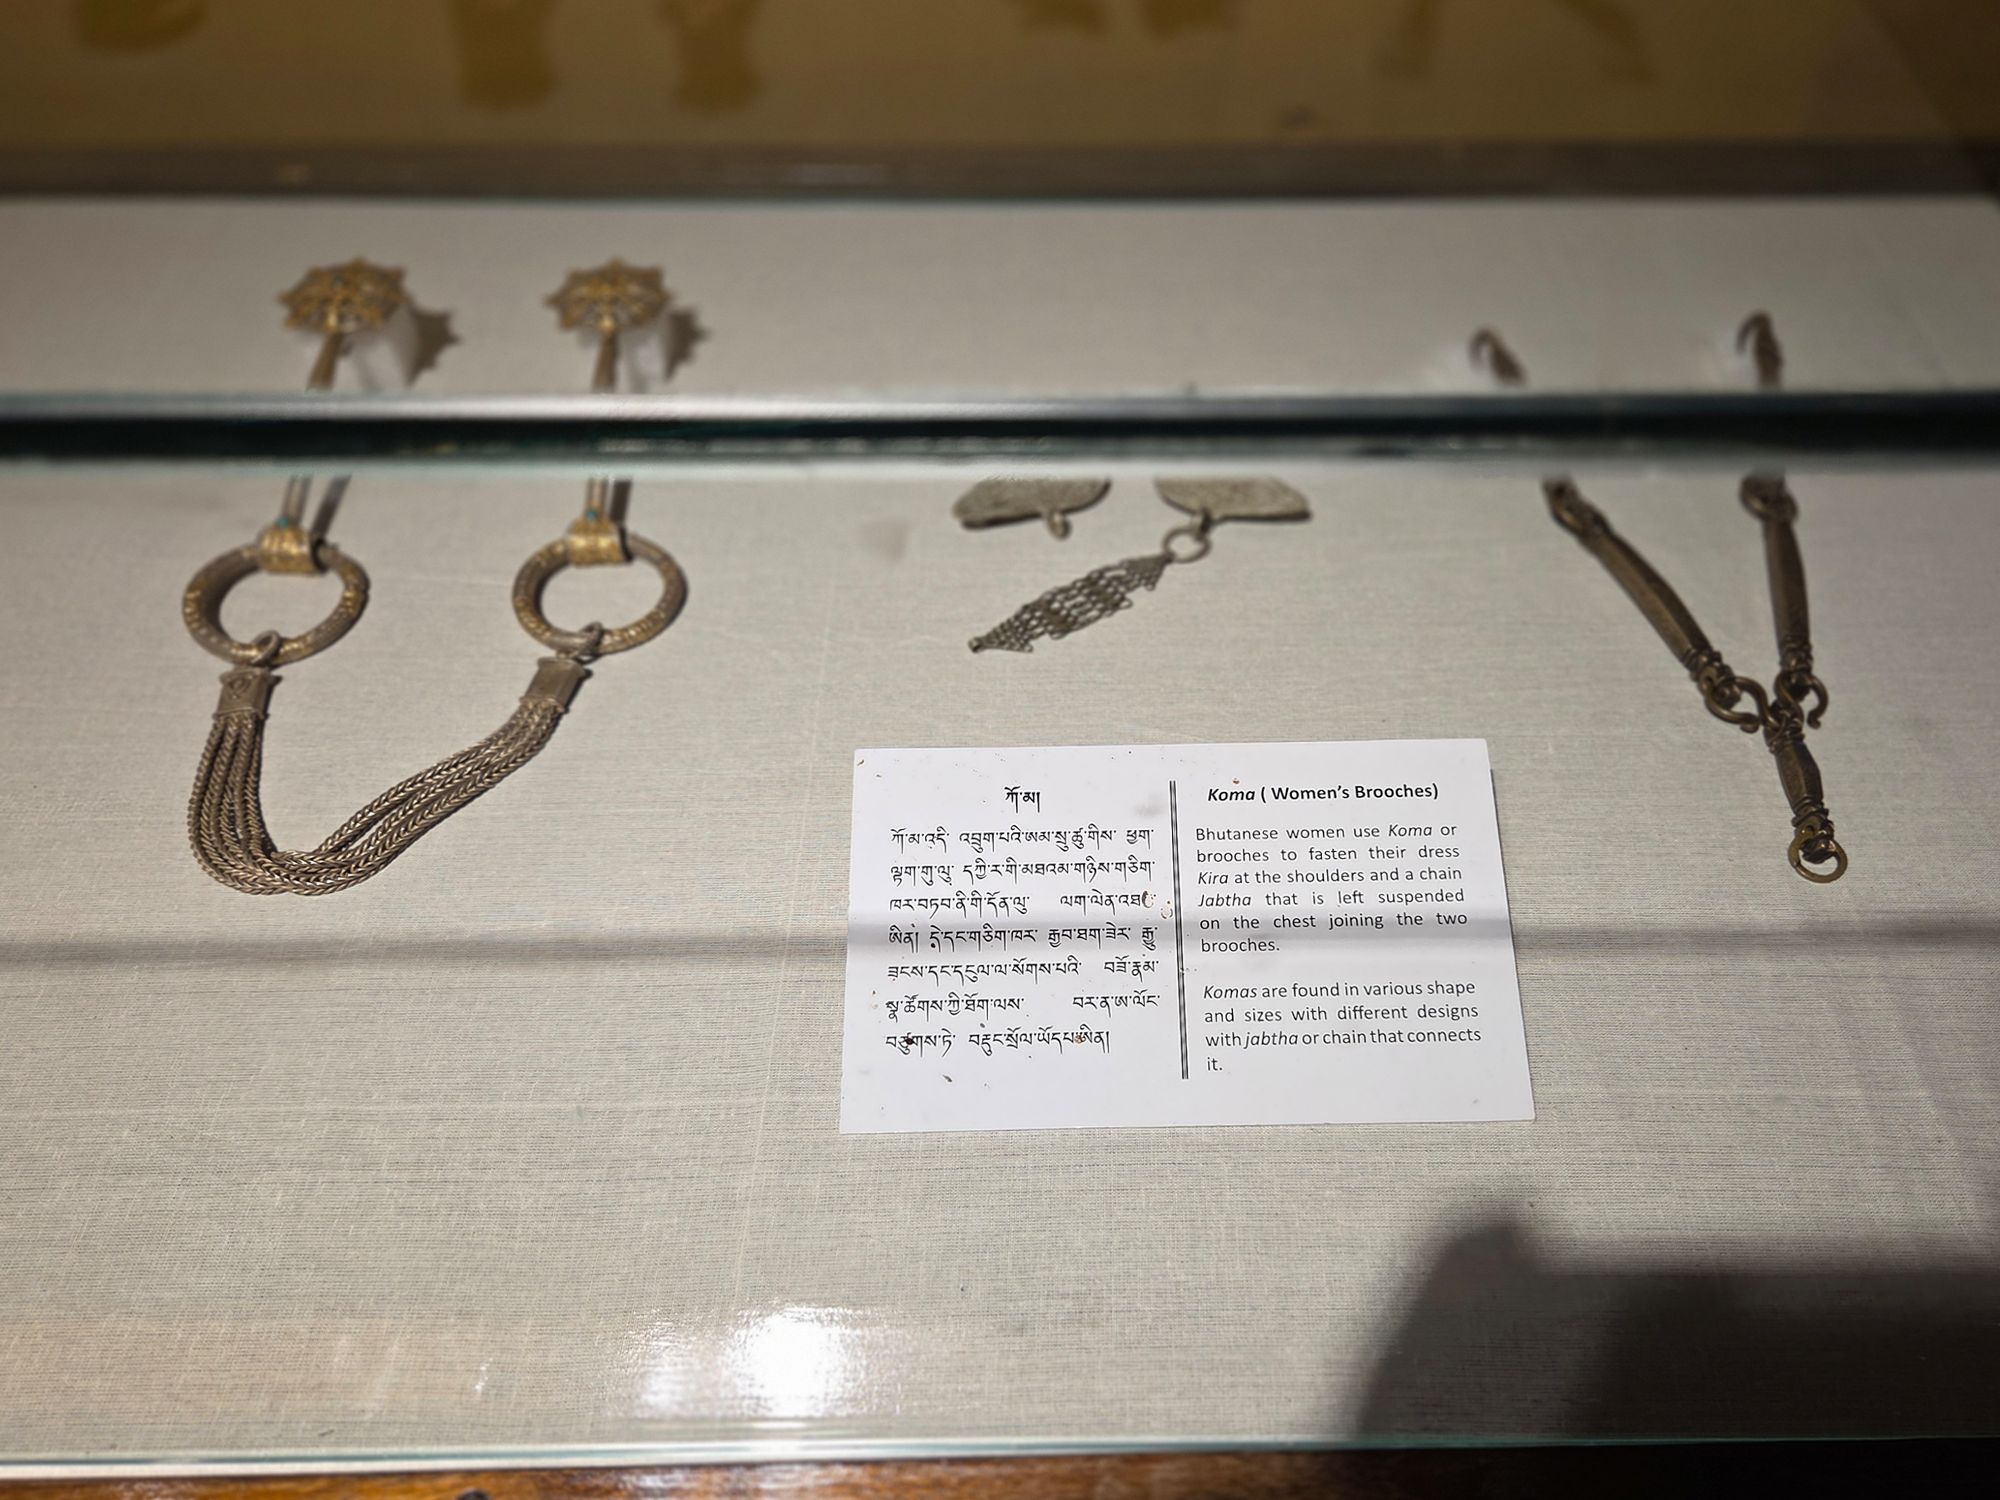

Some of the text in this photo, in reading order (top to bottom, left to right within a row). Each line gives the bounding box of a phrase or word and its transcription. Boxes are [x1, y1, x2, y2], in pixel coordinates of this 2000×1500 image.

[1004, 786, 1040, 813] ཀོ་མ།
[1208, 789, 1255, 801] Koma
[1355, 783, 1438, 800] Brooches)
[891, 826, 949, 854] ཀོ་མ་འདི་
[1196, 824, 1456, 840] Bhutanese women use Koma or
[1197, 845, 1459, 862] brooches to fasten their dress
[1198, 867, 1461, 884] Kira at the shoulders and a chain
[1198, 888, 1464, 907] Jabtha that is left suspended
[1200, 912, 1467, 930] on the chest joining the two
[1202, 938, 1279, 952] brooches.
[1204, 981, 1475, 999] Komas are found in various shape
[1205, 1004, 1478, 1022] and sizes with different designs
[1206, 1029, 1481, 1049] with jabtha or chain that connects
[1208, 1057, 1222, 1071] it.
